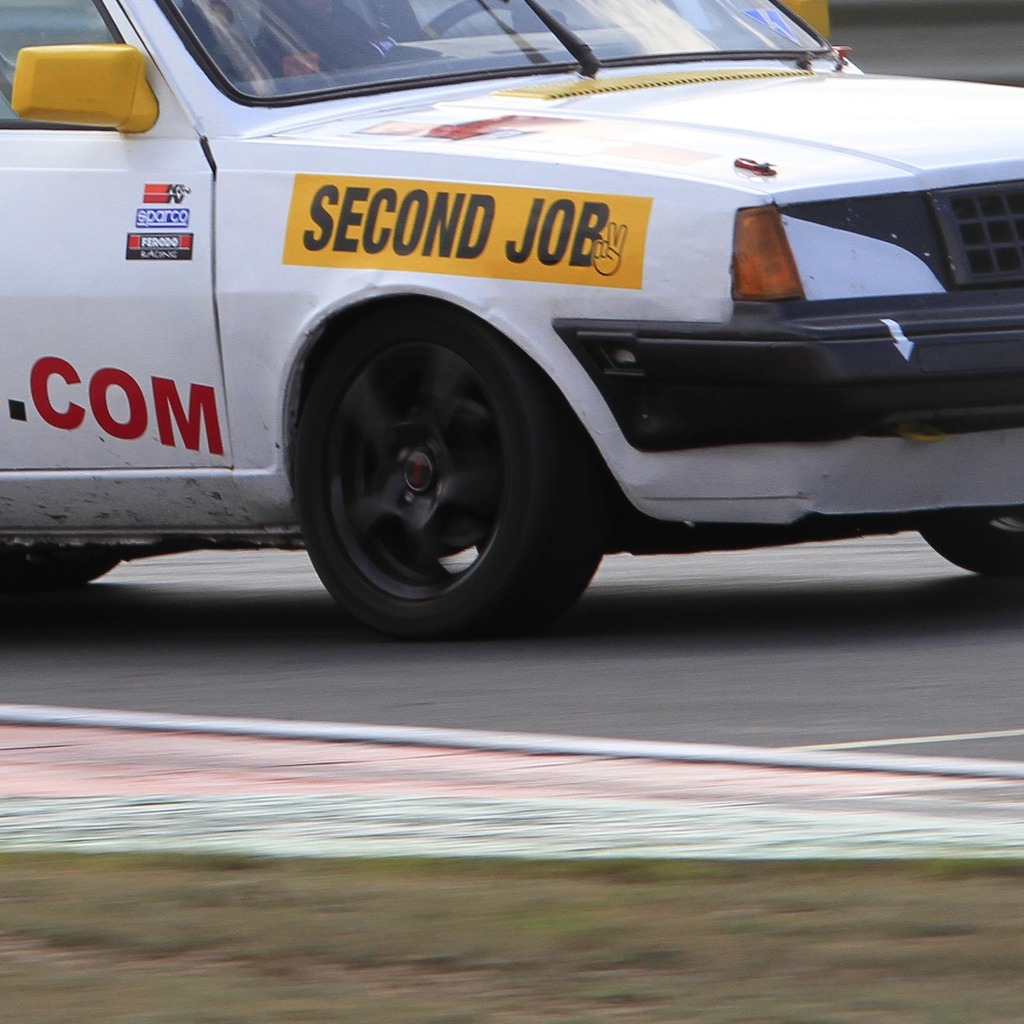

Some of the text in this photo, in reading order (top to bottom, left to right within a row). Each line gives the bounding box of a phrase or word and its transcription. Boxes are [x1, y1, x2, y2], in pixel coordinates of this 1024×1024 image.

[137, 209, 188, 226] sparco
[302, 184, 612, 268] SECOND JOB
[141, 237, 179, 248] FERODO
[140, 250, 178, 259] RACING
